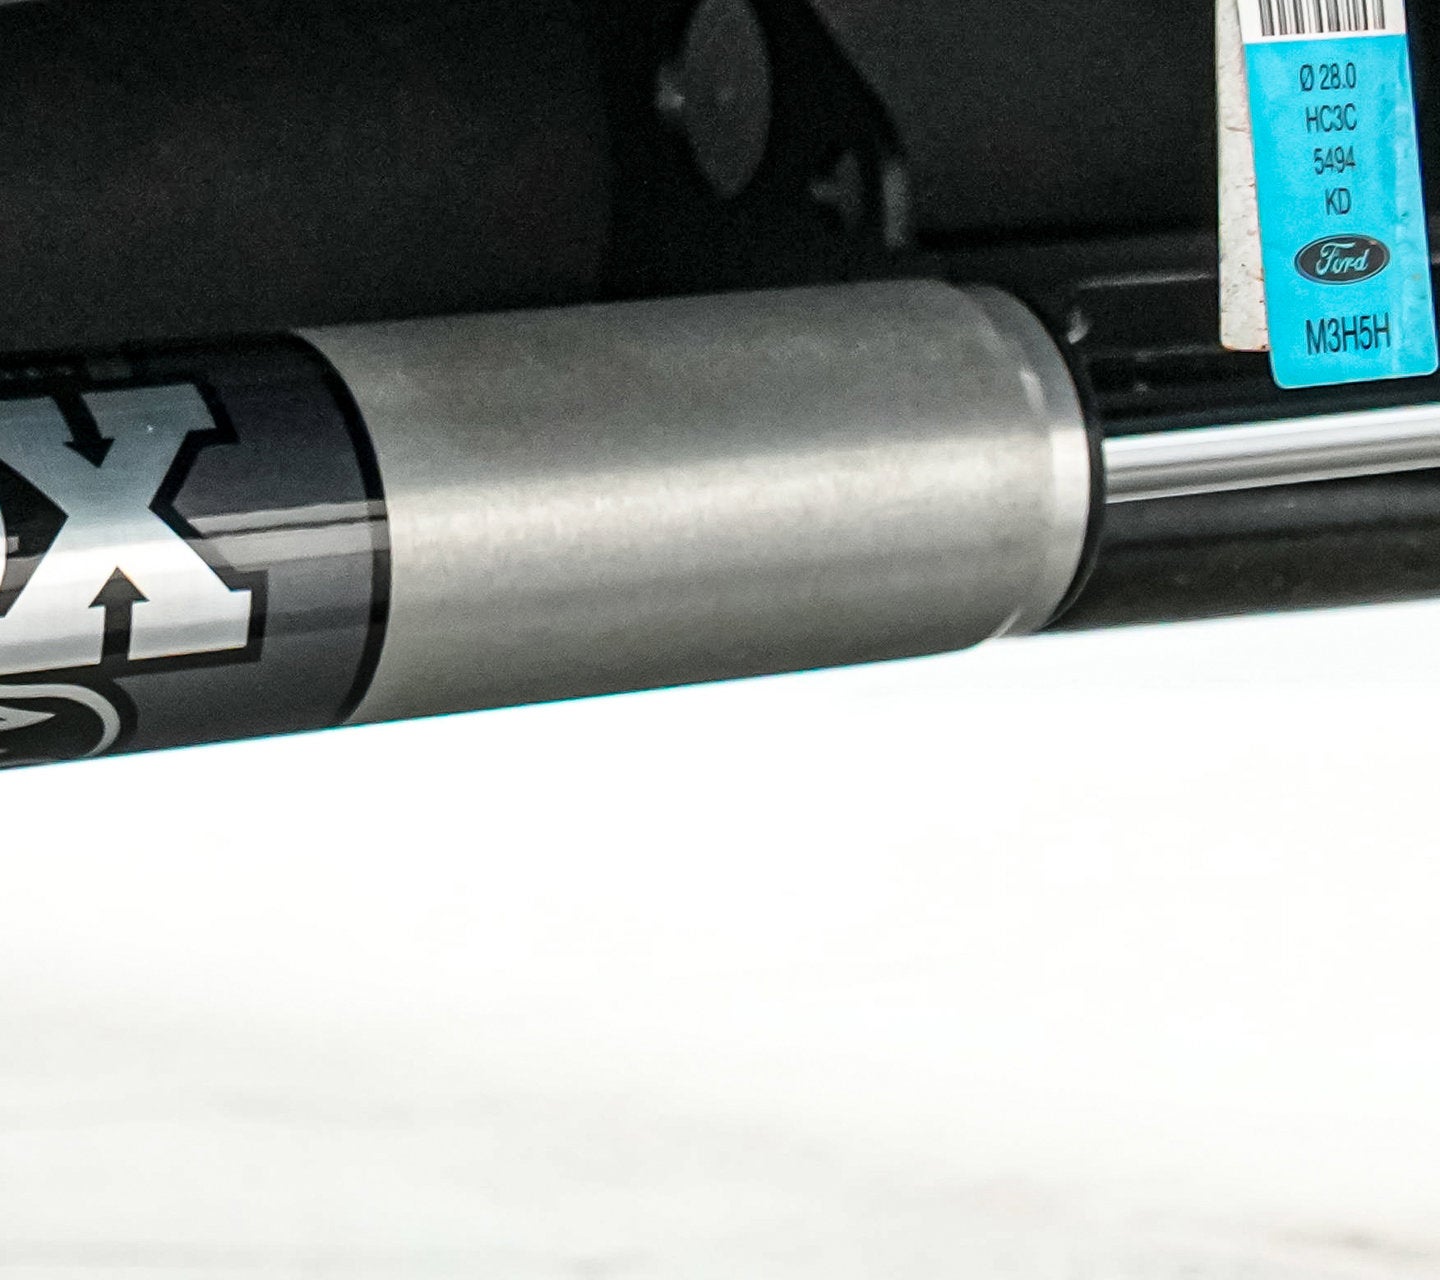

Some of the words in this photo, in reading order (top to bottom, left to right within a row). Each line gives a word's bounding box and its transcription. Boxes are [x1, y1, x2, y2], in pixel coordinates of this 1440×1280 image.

[1319, 61, 1357, 91] 28.0
[1305, 103, 1358, 133] HC3C
[1313, 145, 1357, 175] 5494
[1324, 187, 1352, 216] KD
[1315, 241, 1371, 276] Ford
[1305, 311, 1392, 356] M3H5H
